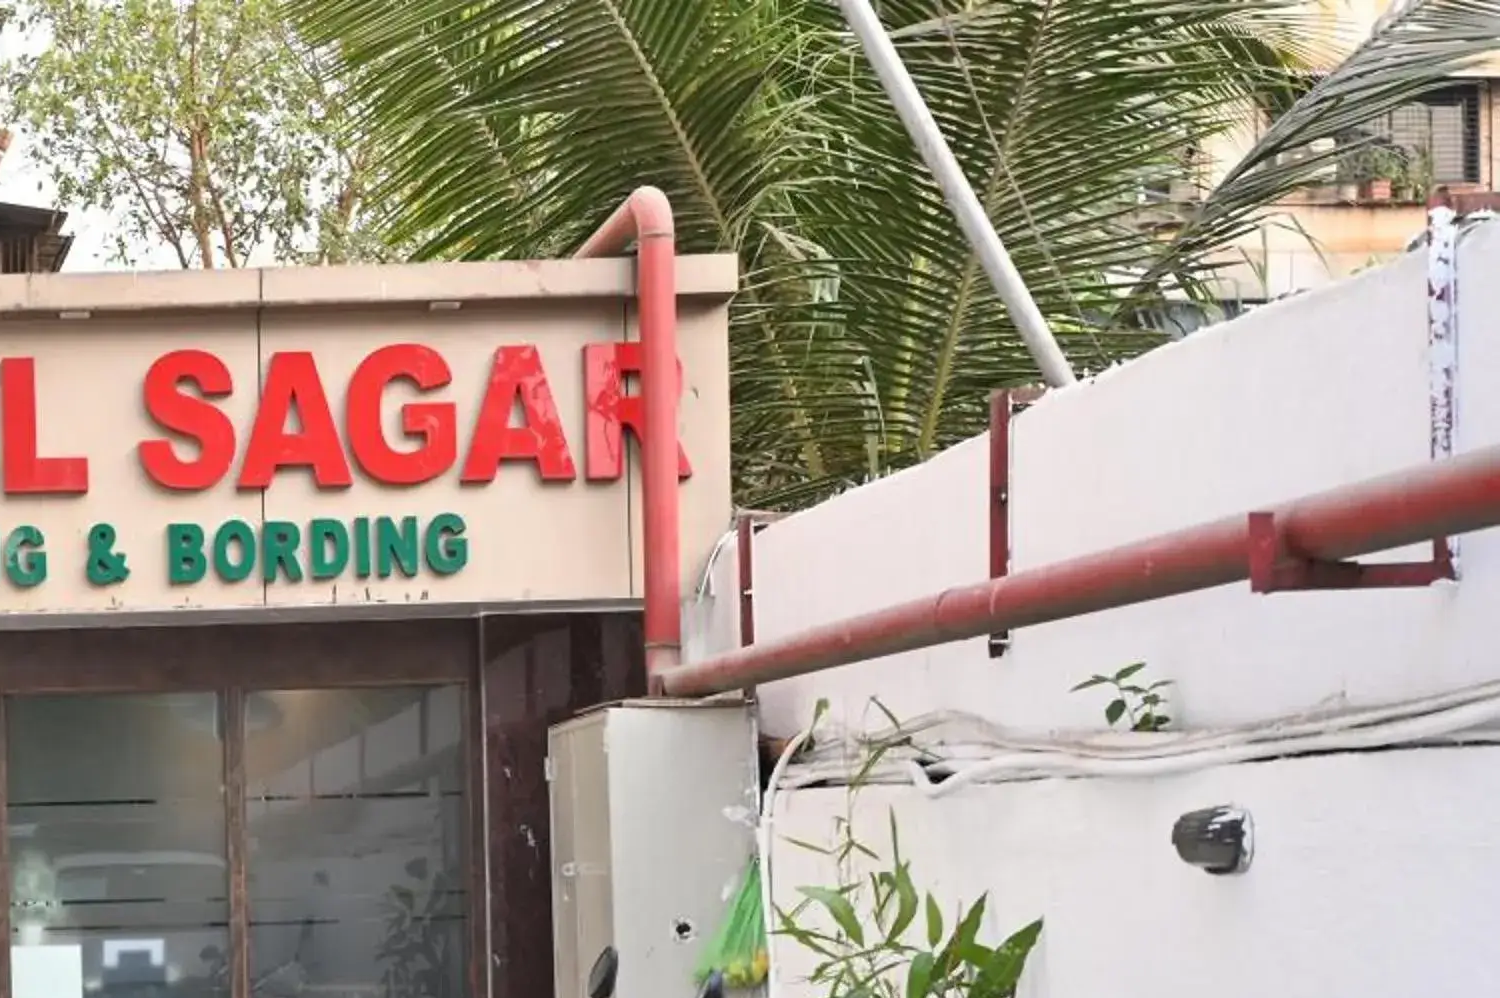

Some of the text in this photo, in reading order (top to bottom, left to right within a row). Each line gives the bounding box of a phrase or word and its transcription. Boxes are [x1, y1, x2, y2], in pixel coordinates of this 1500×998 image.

[138, 341, 693, 491] SAGAR
[85, 522, 129, 586] &
[167, 513, 468, 586] BORDING
